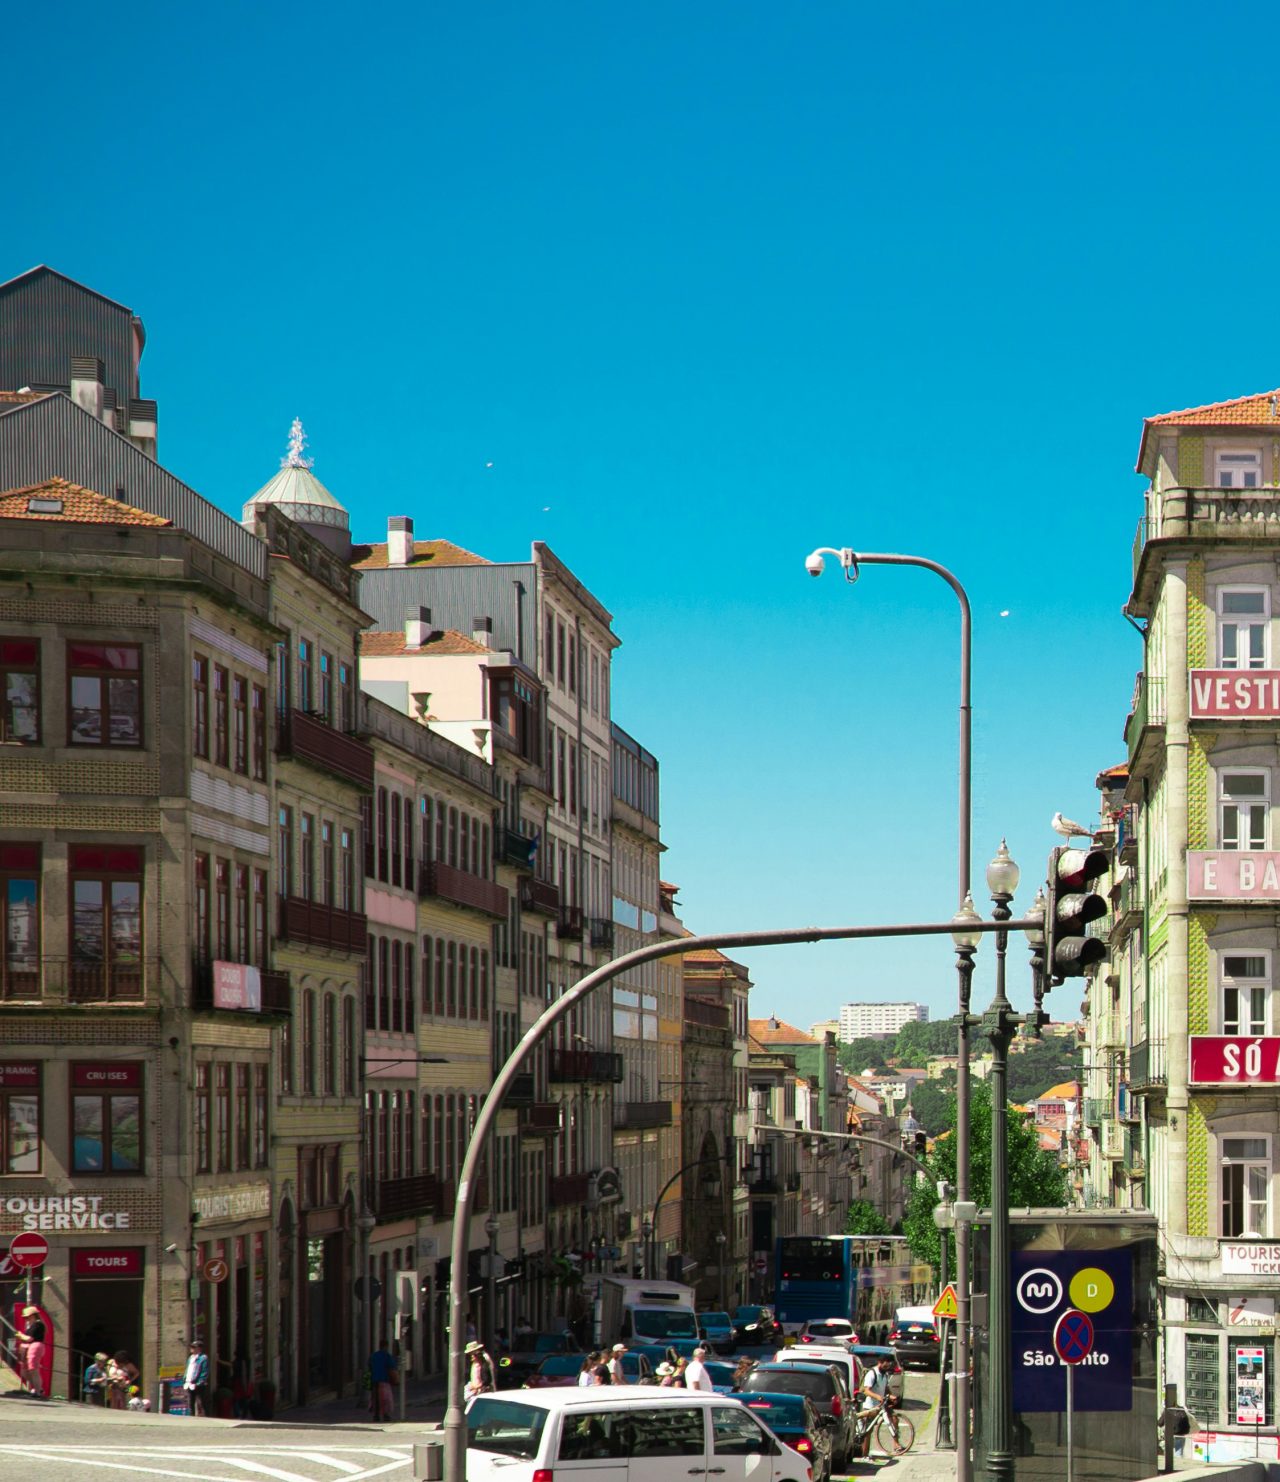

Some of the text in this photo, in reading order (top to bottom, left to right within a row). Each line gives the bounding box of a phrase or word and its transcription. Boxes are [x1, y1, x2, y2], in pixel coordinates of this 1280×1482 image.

[1204, 859, 1218, 891] E
[1222, 1038, 1264, 1077] SÓ
[86, 1071, 128, 1081] CRUISES
[194, 1195, 234, 1219] TOURIST
[23, 1212, 130, 1230] SERVICE
[87, 1257, 128, 1267] TOURS
[1087, 1283, 1098, 1298] D
[1022, 1350, 1109, 1366] São nto
